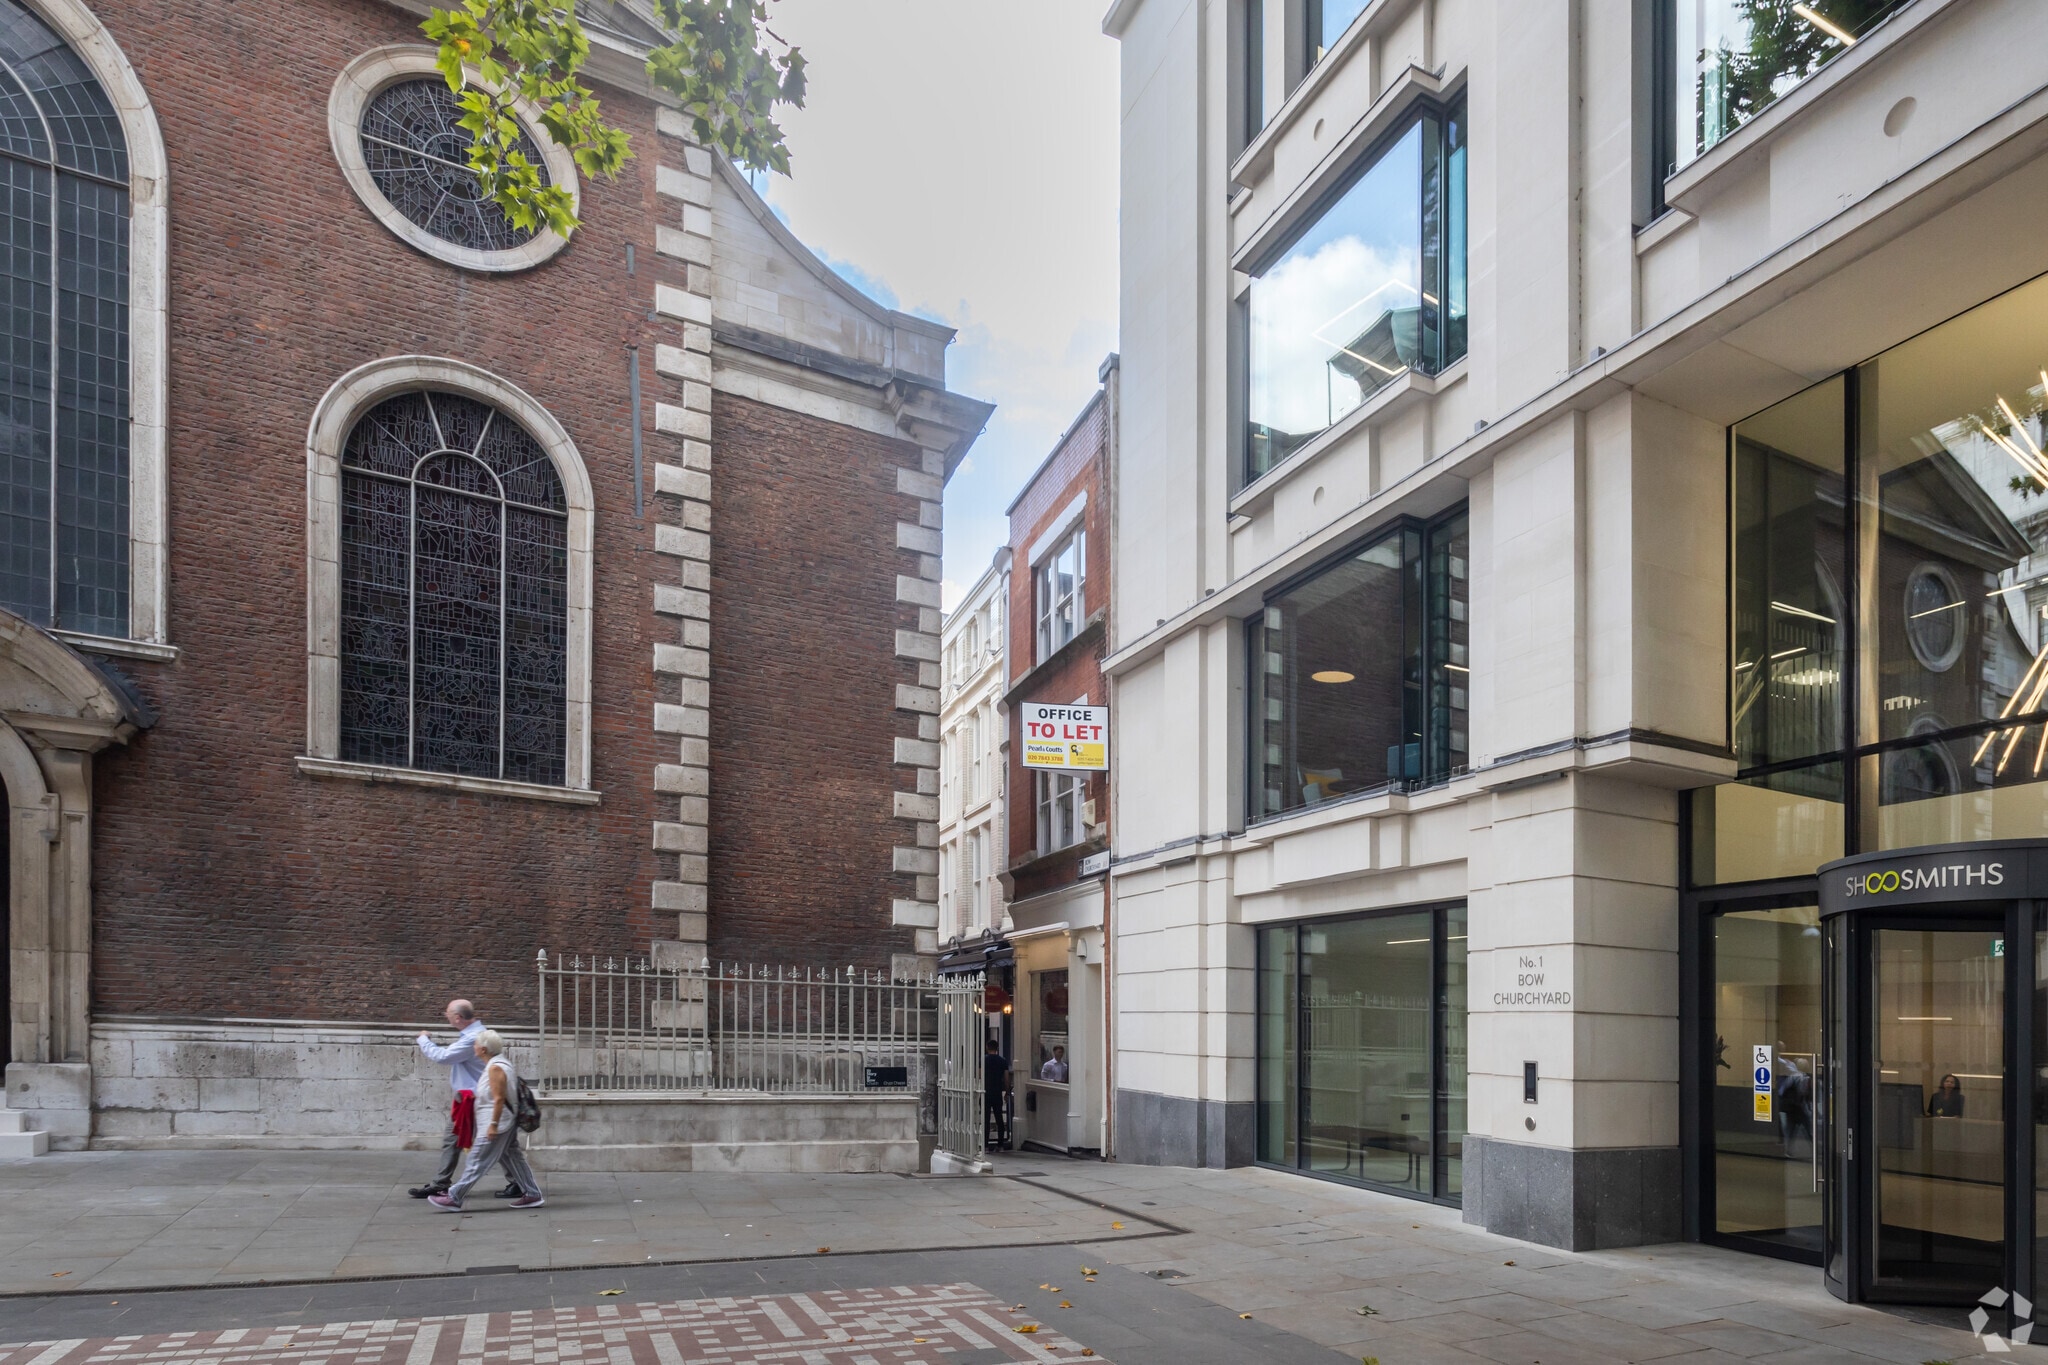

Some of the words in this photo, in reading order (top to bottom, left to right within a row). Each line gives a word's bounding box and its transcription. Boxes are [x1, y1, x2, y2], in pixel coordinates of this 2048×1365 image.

[1038, 708, 1092, 721] OFFICE
[1027, 722, 1056, 738] TO
[1063, 724, 1103, 740] LET
[1845, 863, 2004, 897] SHOOSMITHS
[1519, 956, 1536, 968] No.
[1539, 955, 1543, 968] 1
[1518, 973, 1545, 986] BOW
[1493, 992, 1572, 1005] CHURCHYARD
